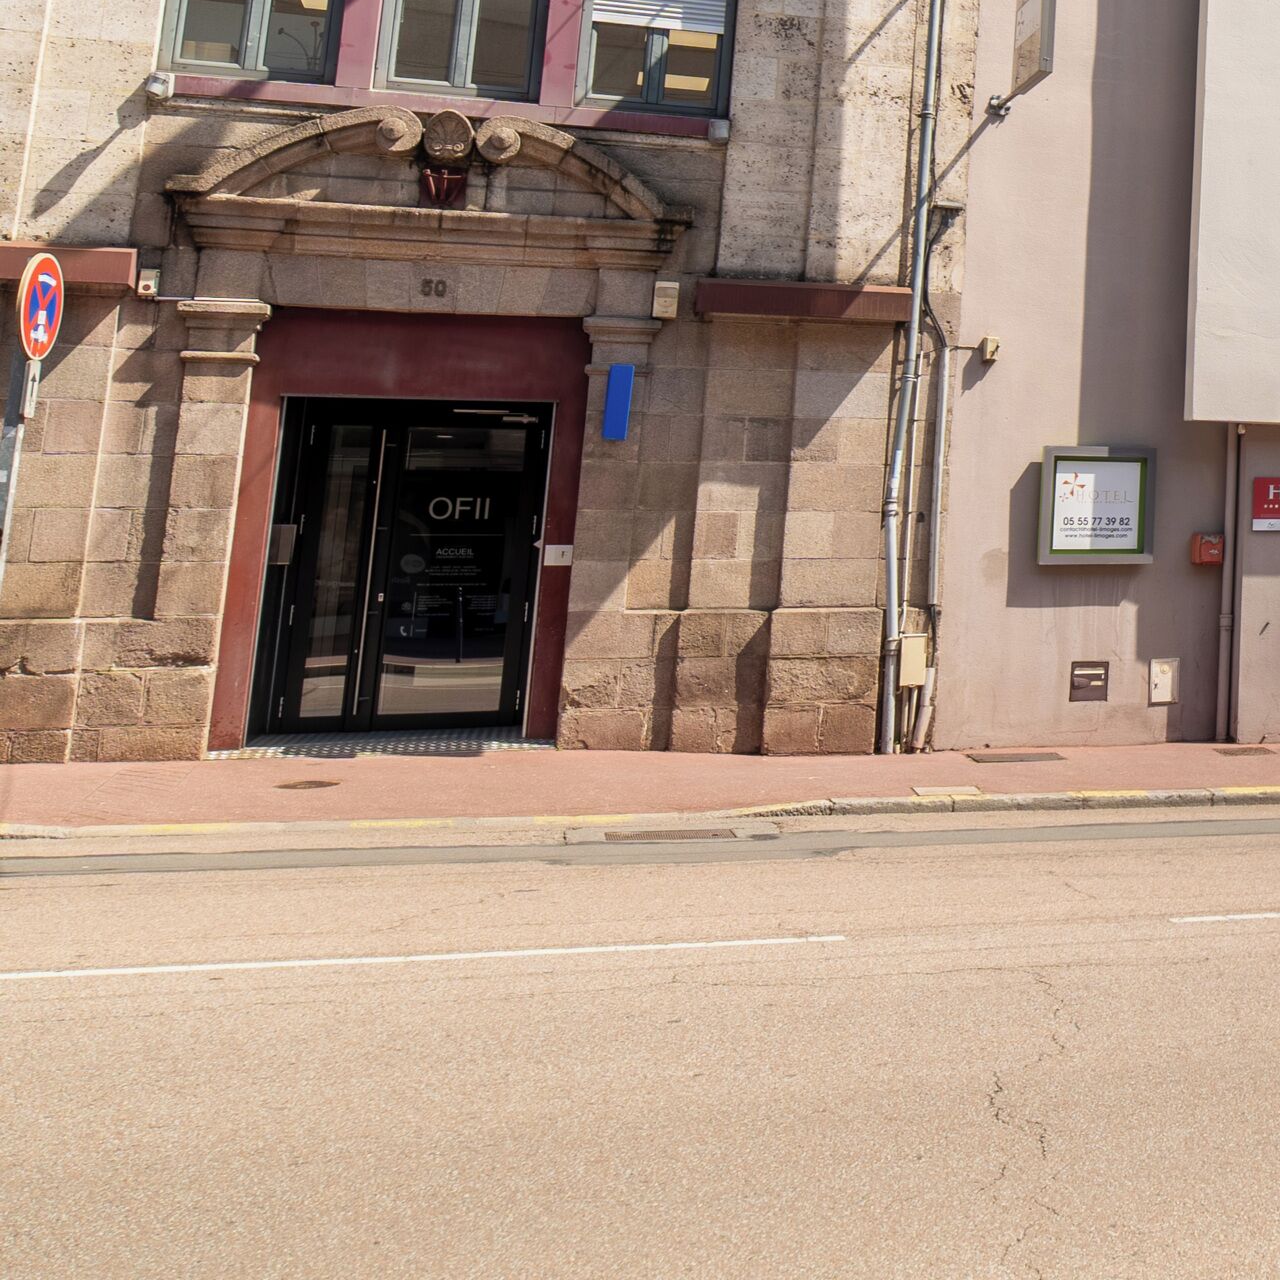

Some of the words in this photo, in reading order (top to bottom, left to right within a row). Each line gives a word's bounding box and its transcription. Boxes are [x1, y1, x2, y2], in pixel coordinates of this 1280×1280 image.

[421, 279, 447, 297] 50
[1076, 490, 1136, 503] HOTEL
[428, 497, 490, 520] OFII
[1063, 517, 1075, 526] 05
[1077, 517, 1088, 526] 55
[1091, 517, 1102, 526] 77
[1105, 517, 1117, 526] 39
[1119, 517, 1130, 526] 82
[435, 548, 474, 556] ACCUEIL
